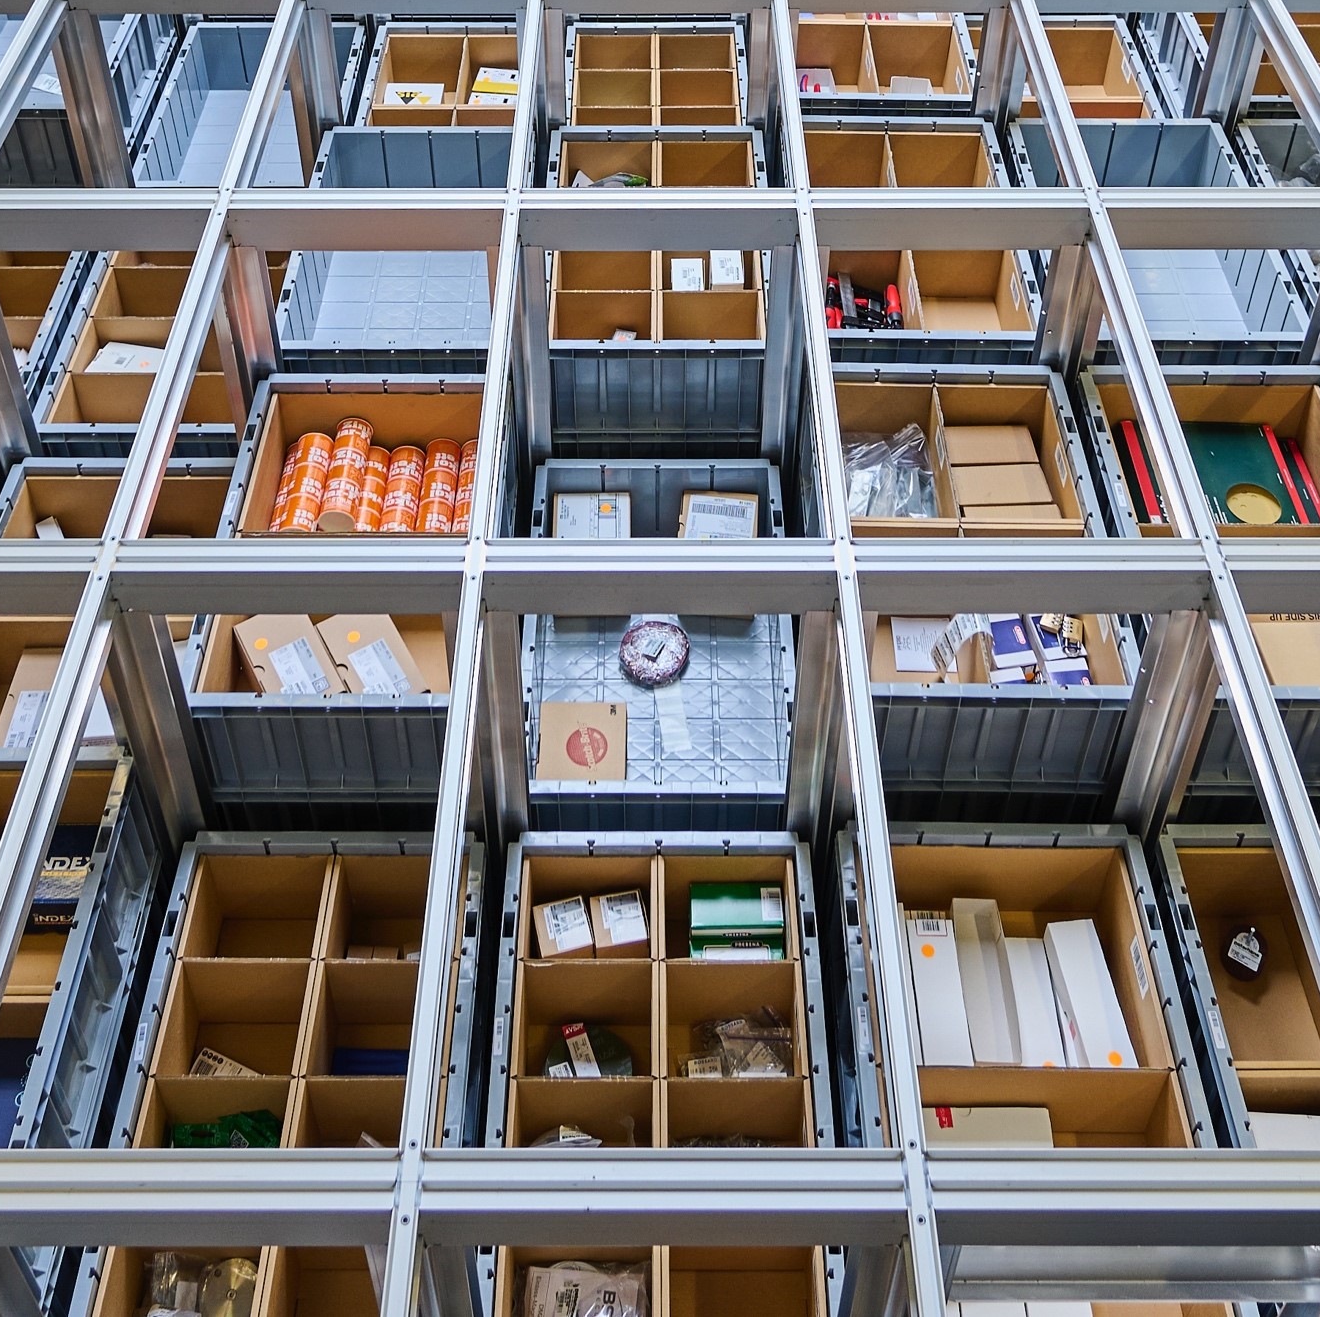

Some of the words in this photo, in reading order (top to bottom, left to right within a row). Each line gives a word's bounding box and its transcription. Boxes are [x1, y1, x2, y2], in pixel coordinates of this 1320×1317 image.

[1270, 613, 1282, 621] UP
[610, 704, 617, 716] 3M
[43, 856, 91, 872] NDEX
